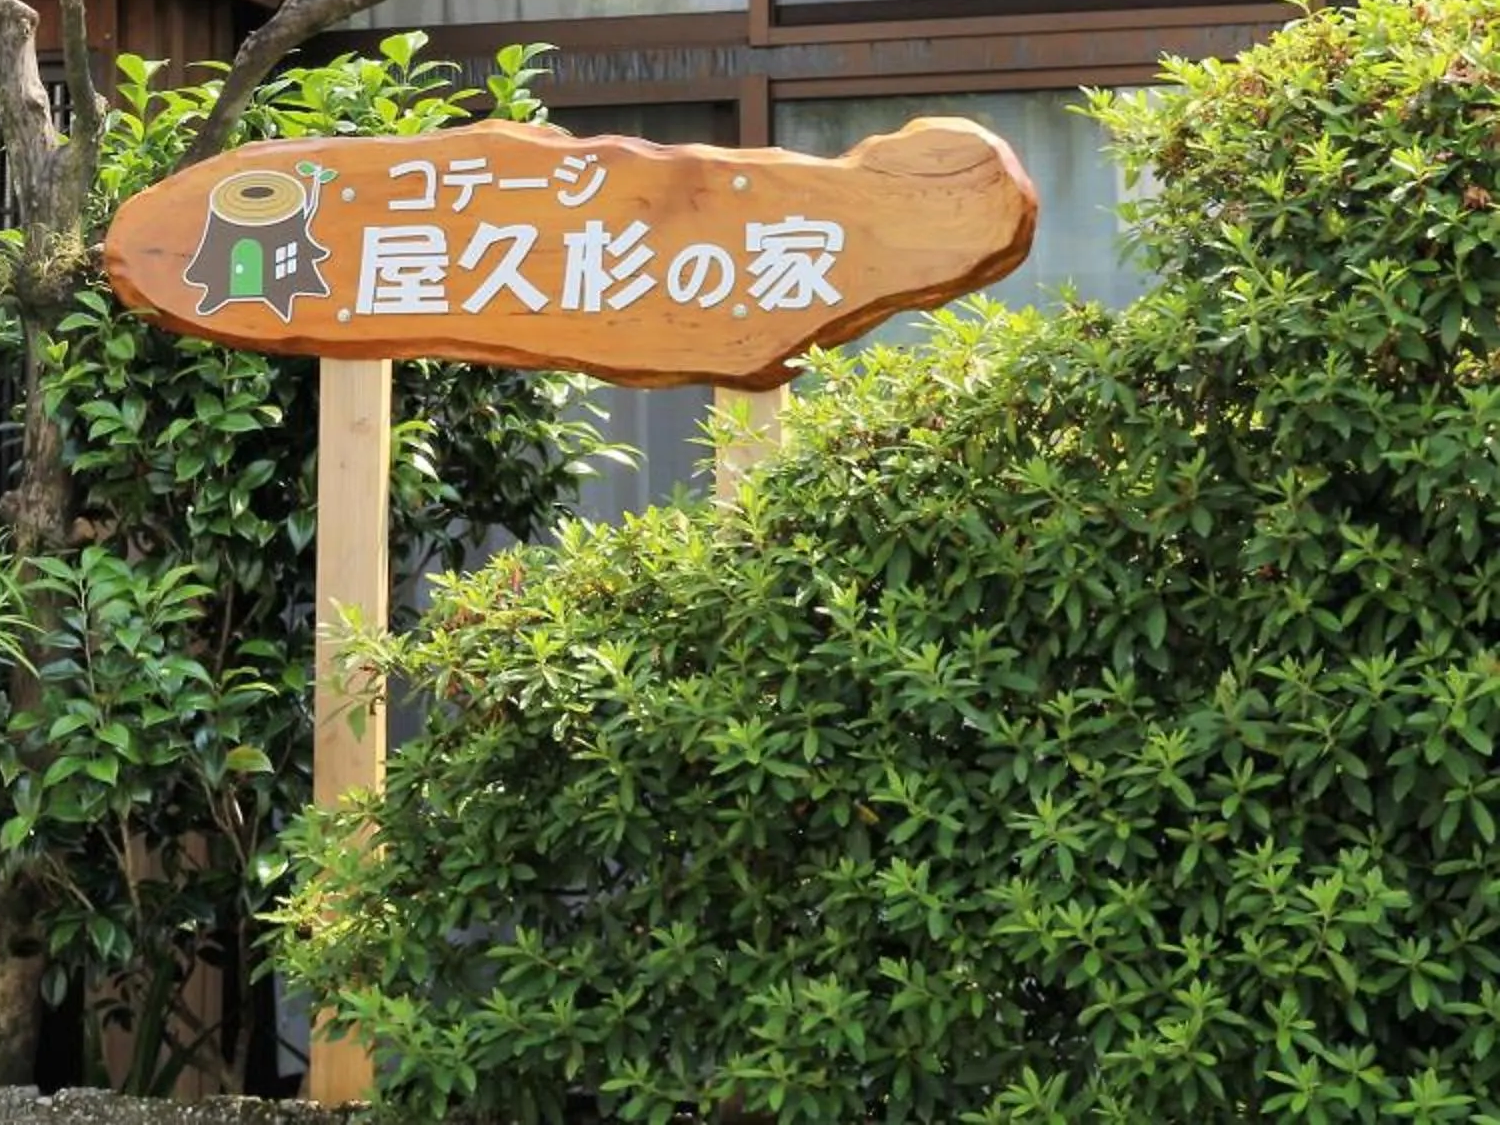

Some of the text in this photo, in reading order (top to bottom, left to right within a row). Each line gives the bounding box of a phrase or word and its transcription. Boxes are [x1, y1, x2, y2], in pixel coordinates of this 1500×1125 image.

[387, 153, 607, 212] コテージ
[354, 215, 845, 315] 屋久杉の家
